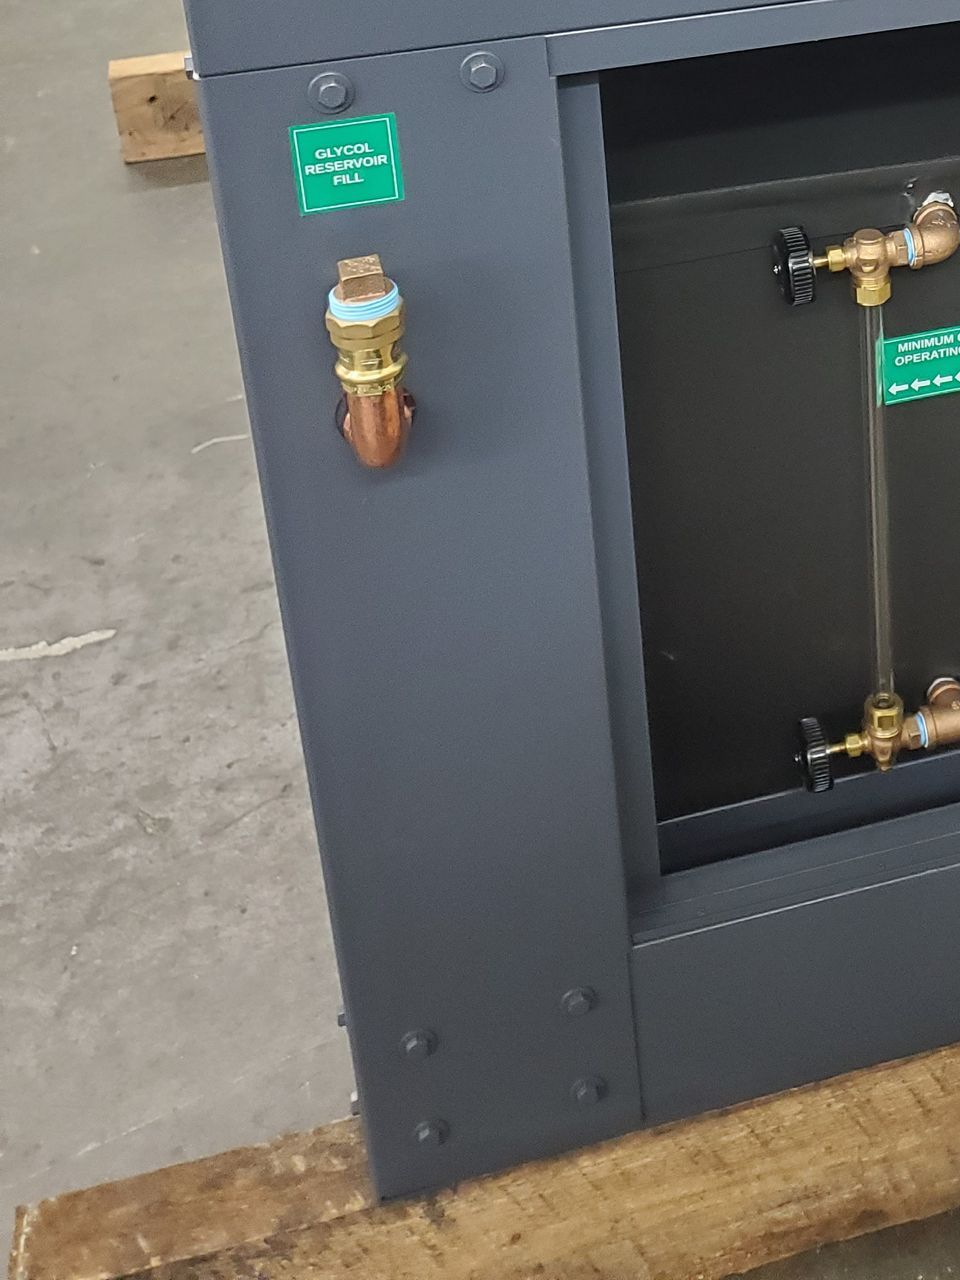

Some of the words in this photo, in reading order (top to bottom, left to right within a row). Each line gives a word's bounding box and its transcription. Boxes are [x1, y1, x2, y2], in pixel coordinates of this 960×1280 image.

[315, 143, 374, 159] GLYCOL
[305, 154, 388, 175] RESERVOIR
[333, 173, 364, 186] FILL
[898, 334, 954, 353] MINIMUM
